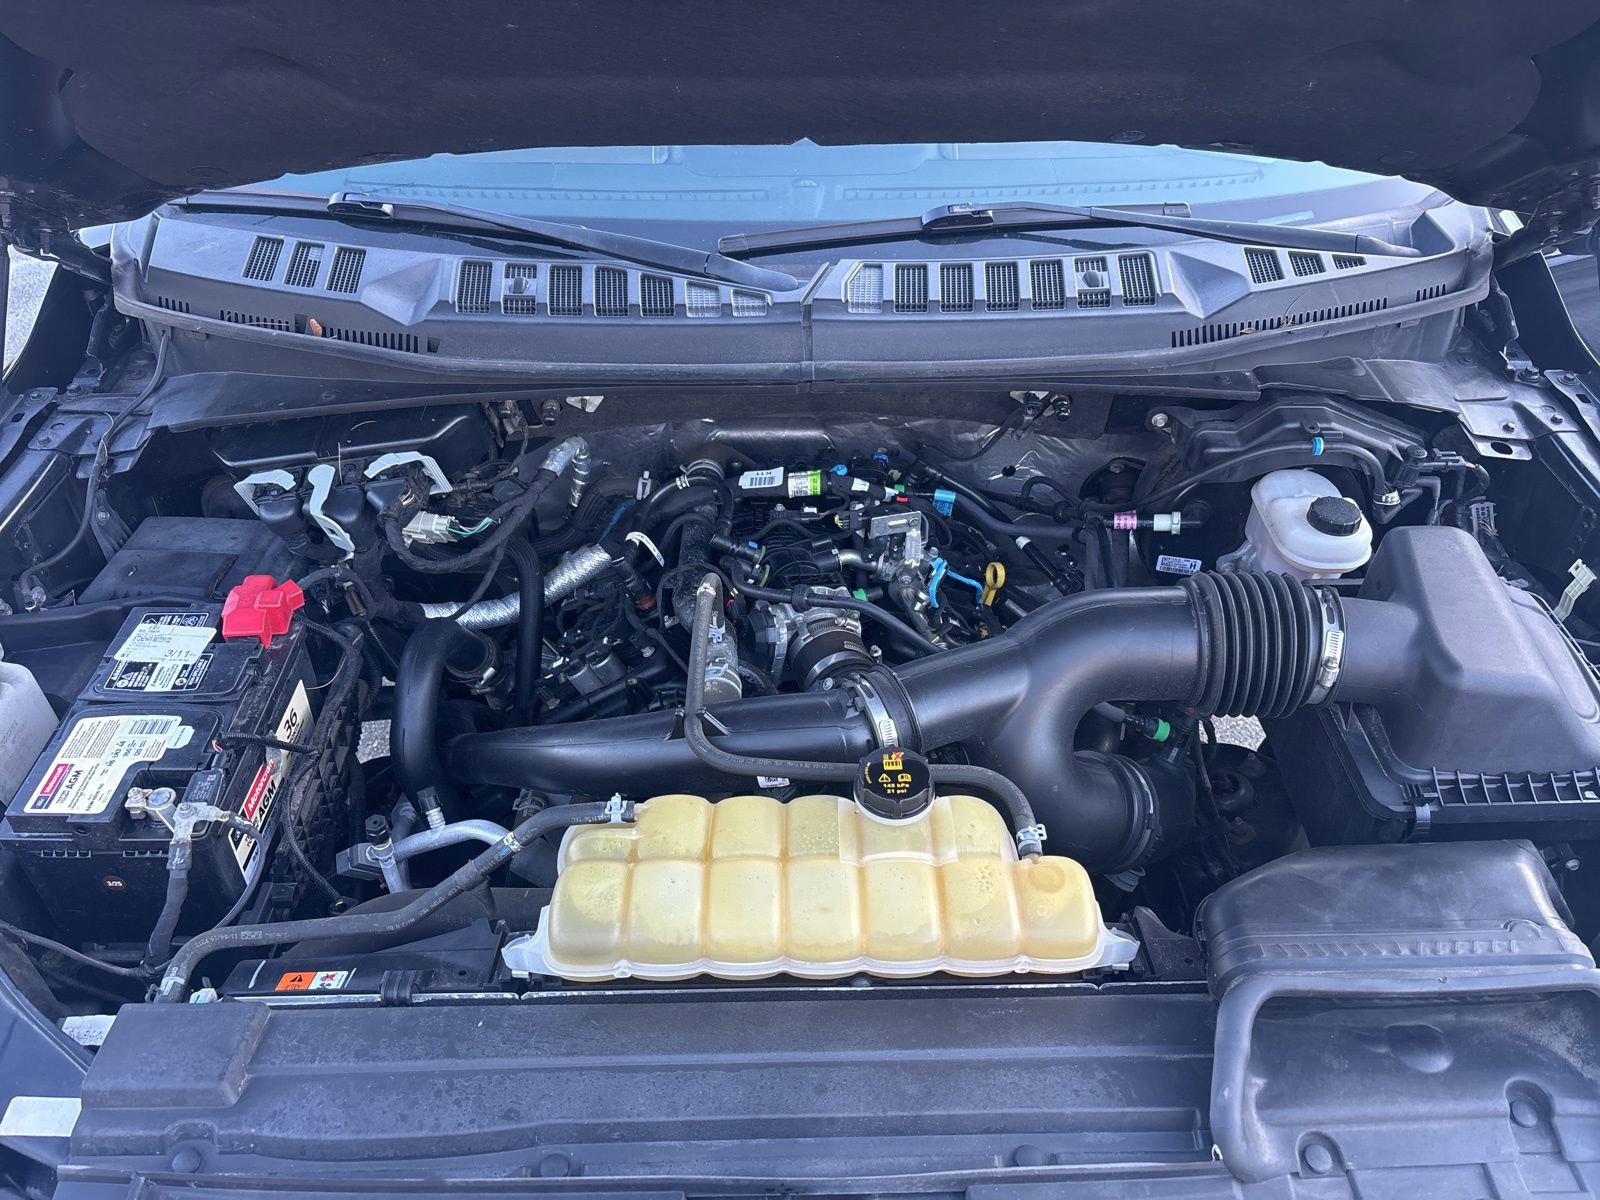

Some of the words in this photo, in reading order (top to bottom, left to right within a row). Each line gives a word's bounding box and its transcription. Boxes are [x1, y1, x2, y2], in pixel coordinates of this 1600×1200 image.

[283, 708, 298, 740] 36
[44, 764, 67, 793] Motorcraft
[65, 769, 83, 789] AGM
[246, 758, 275, 812] Motorcraft
[258, 780, 277, 819] AGM
